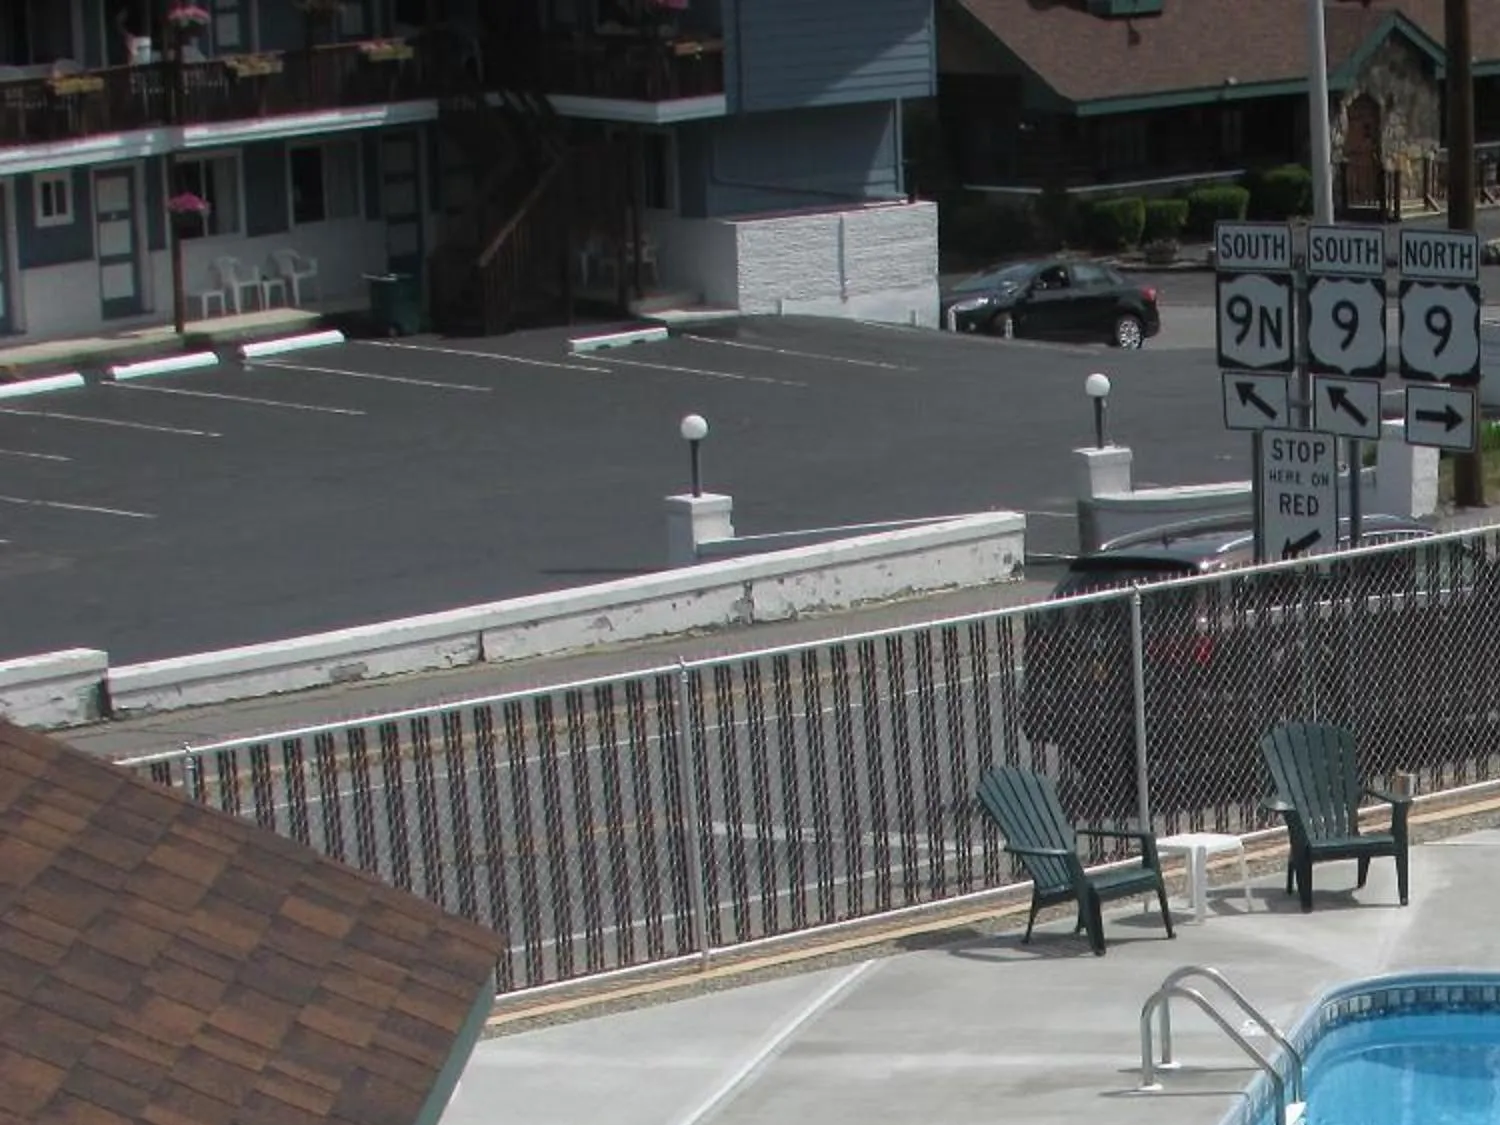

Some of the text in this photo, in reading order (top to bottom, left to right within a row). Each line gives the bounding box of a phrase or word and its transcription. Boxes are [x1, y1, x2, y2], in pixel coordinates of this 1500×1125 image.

[1221, 234, 1286, 261] SOUTH
[1312, 238, 1379, 264] SOUTH
[1405, 241, 1473, 270] NORTH
[1226, 294, 1283, 349] 9N
[1331, 300, 1359, 351] 9
[1425, 305, 1453, 358] 9
[1271, 438, 1326, 464] STOP
[1269, 469, 1329, 487] HERE ON
[1279, 492, 1319, 516] RED
